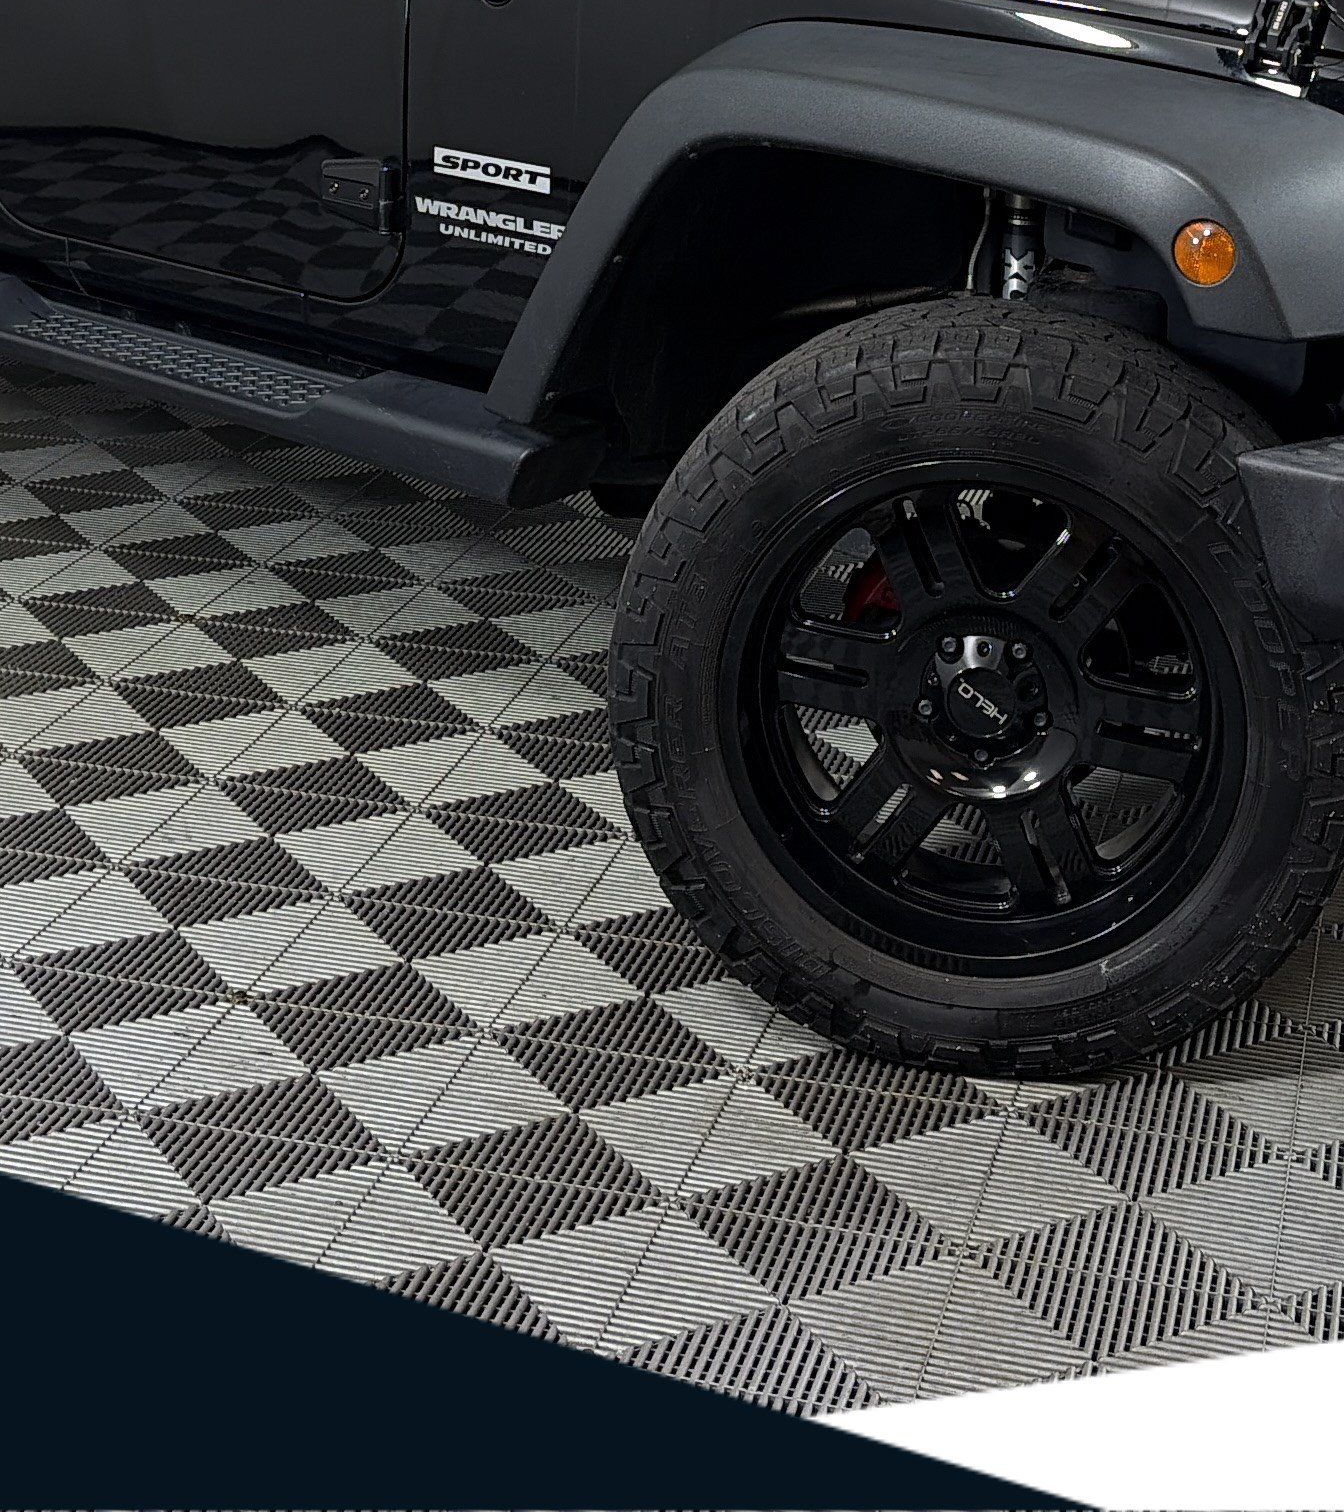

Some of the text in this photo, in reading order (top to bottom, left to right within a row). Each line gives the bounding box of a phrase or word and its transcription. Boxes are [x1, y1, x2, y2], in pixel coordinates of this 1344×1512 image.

[440, 154, 543, 186] SPORT
[439, 223, 552, 255] UNLIMITED
[957, 680, 1008, 726] HELO
